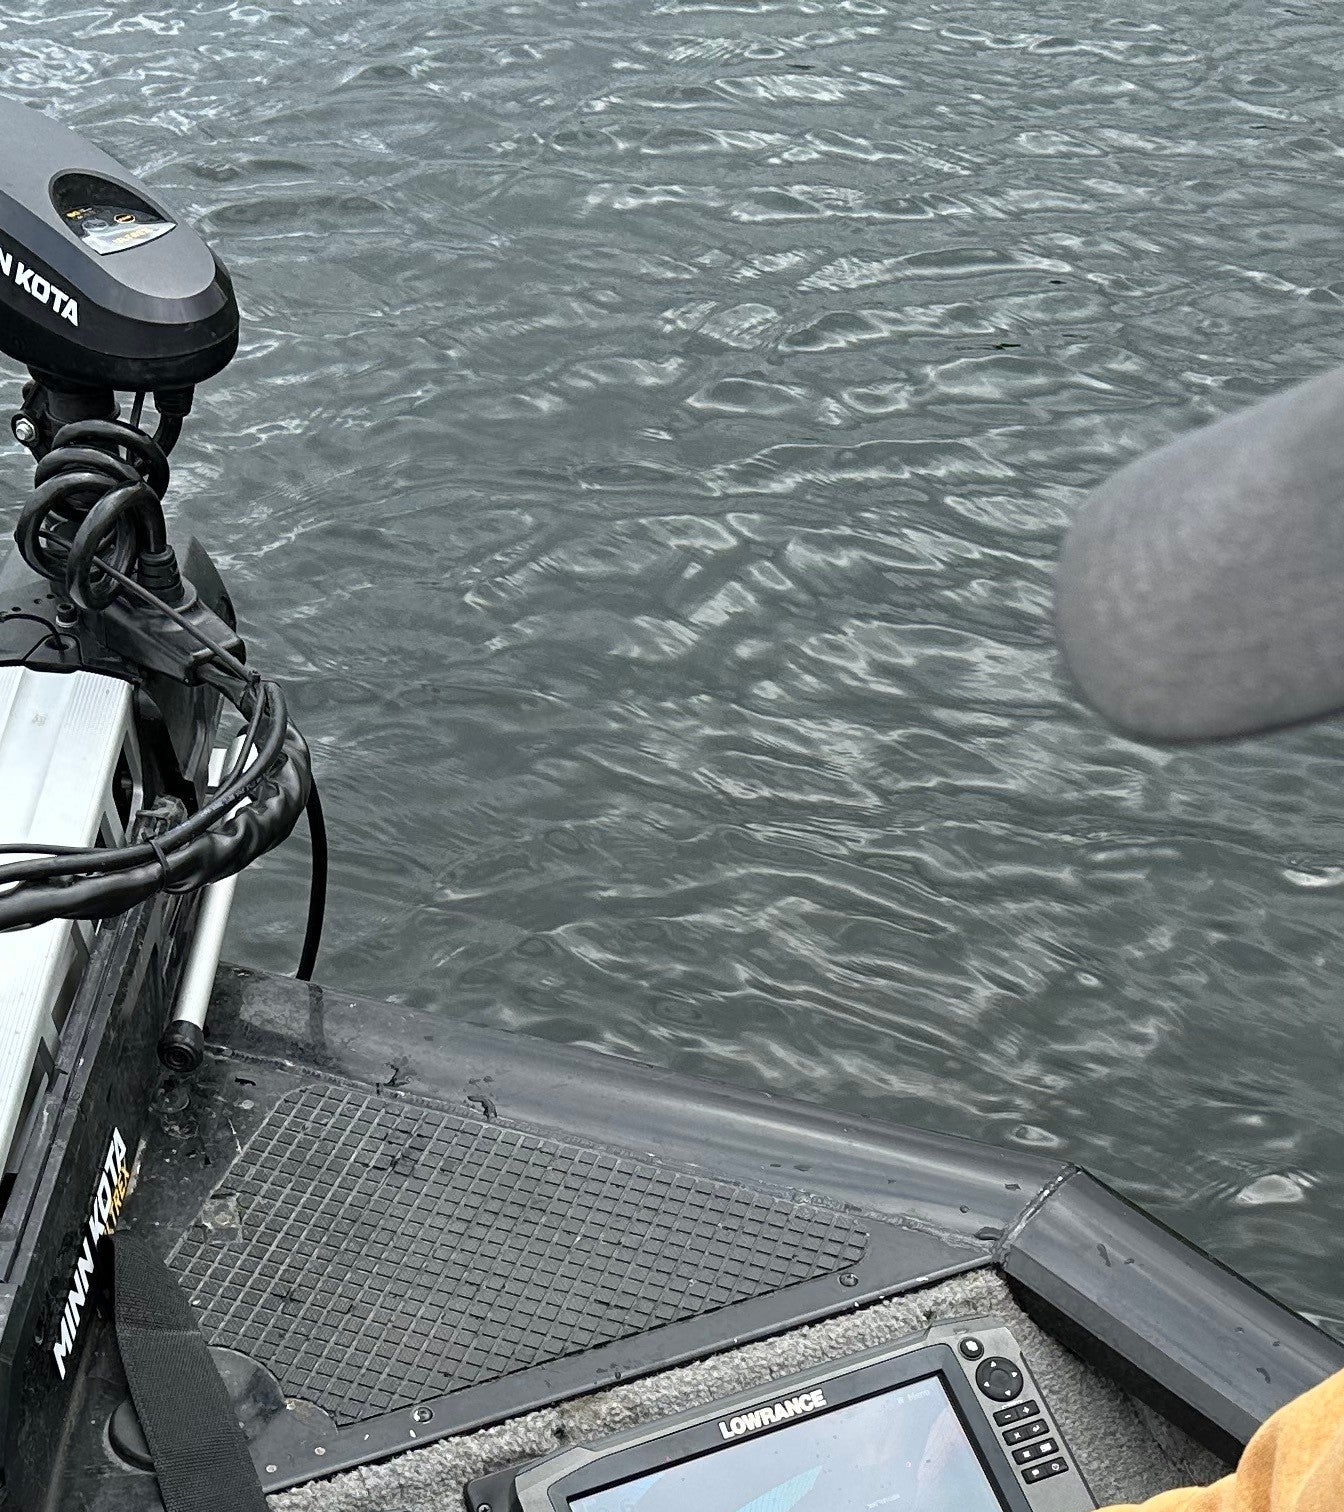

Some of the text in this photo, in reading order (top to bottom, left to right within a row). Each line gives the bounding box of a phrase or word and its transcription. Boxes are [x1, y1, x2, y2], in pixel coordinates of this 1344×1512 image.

[14, 261, 79, 327] KOTA
[53, 1126, 127, 1381] MINN KOTA
[718, 1388, 827, 1439] LOWRANCE
